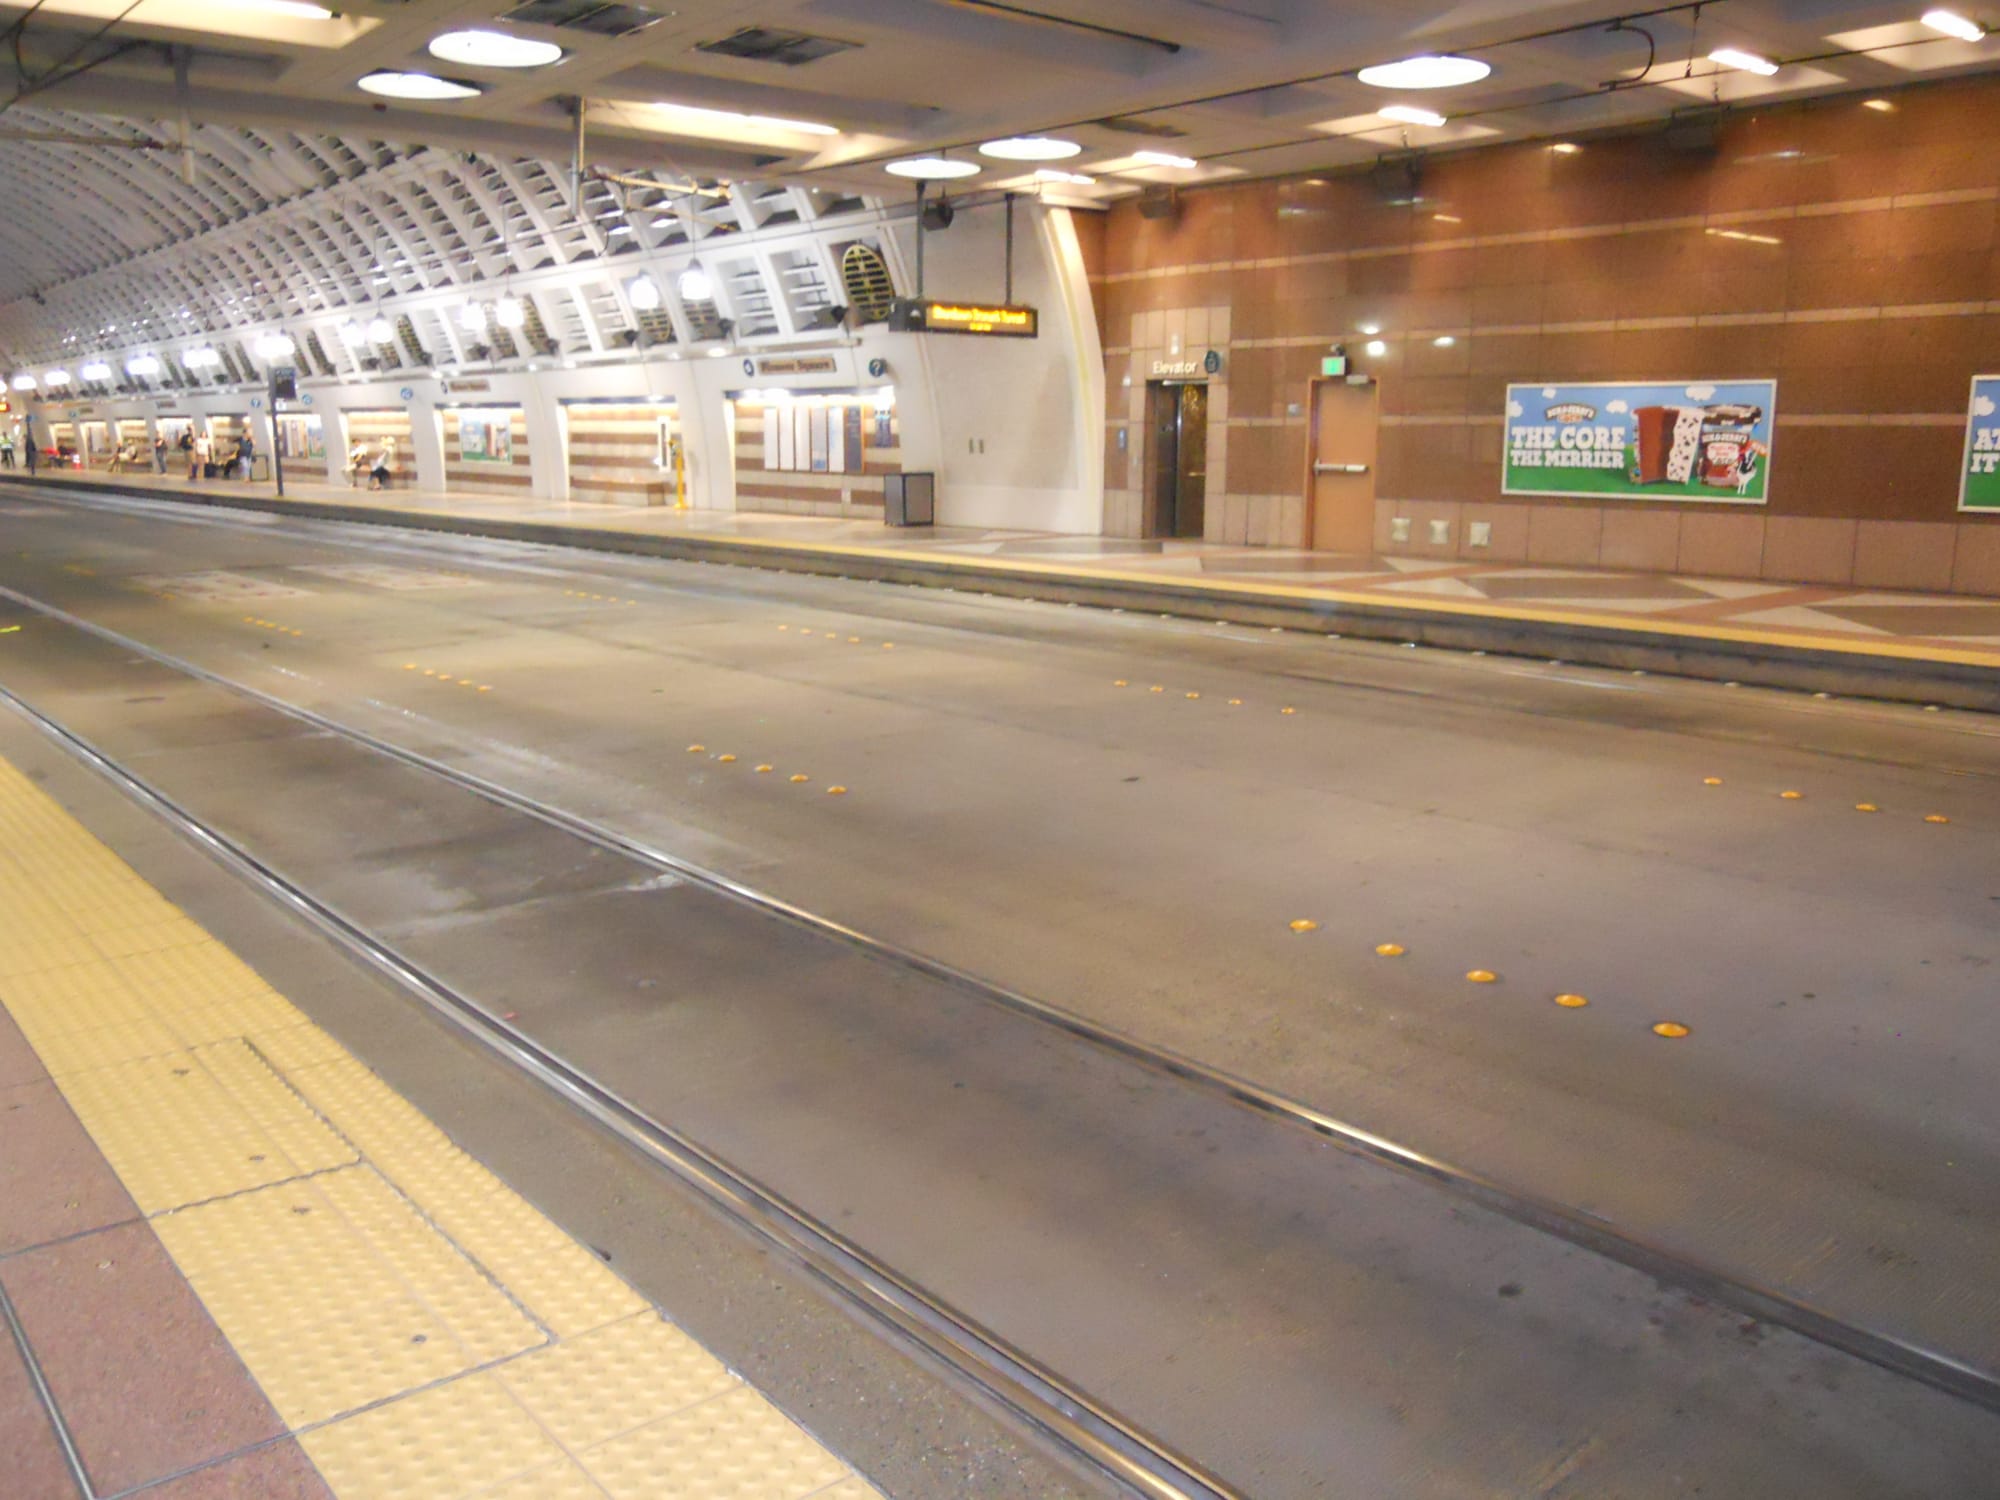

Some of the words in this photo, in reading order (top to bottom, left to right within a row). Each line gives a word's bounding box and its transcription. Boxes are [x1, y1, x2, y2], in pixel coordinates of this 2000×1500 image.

[1153, 360, 1198, 374] Elevator
[1511, 425, 1556, 449] THE
[1560, 426, 1625, 450] CORE
[1510, 449, 1542, 467] THE
[1544, 450, 1625, 469] MERRIER
